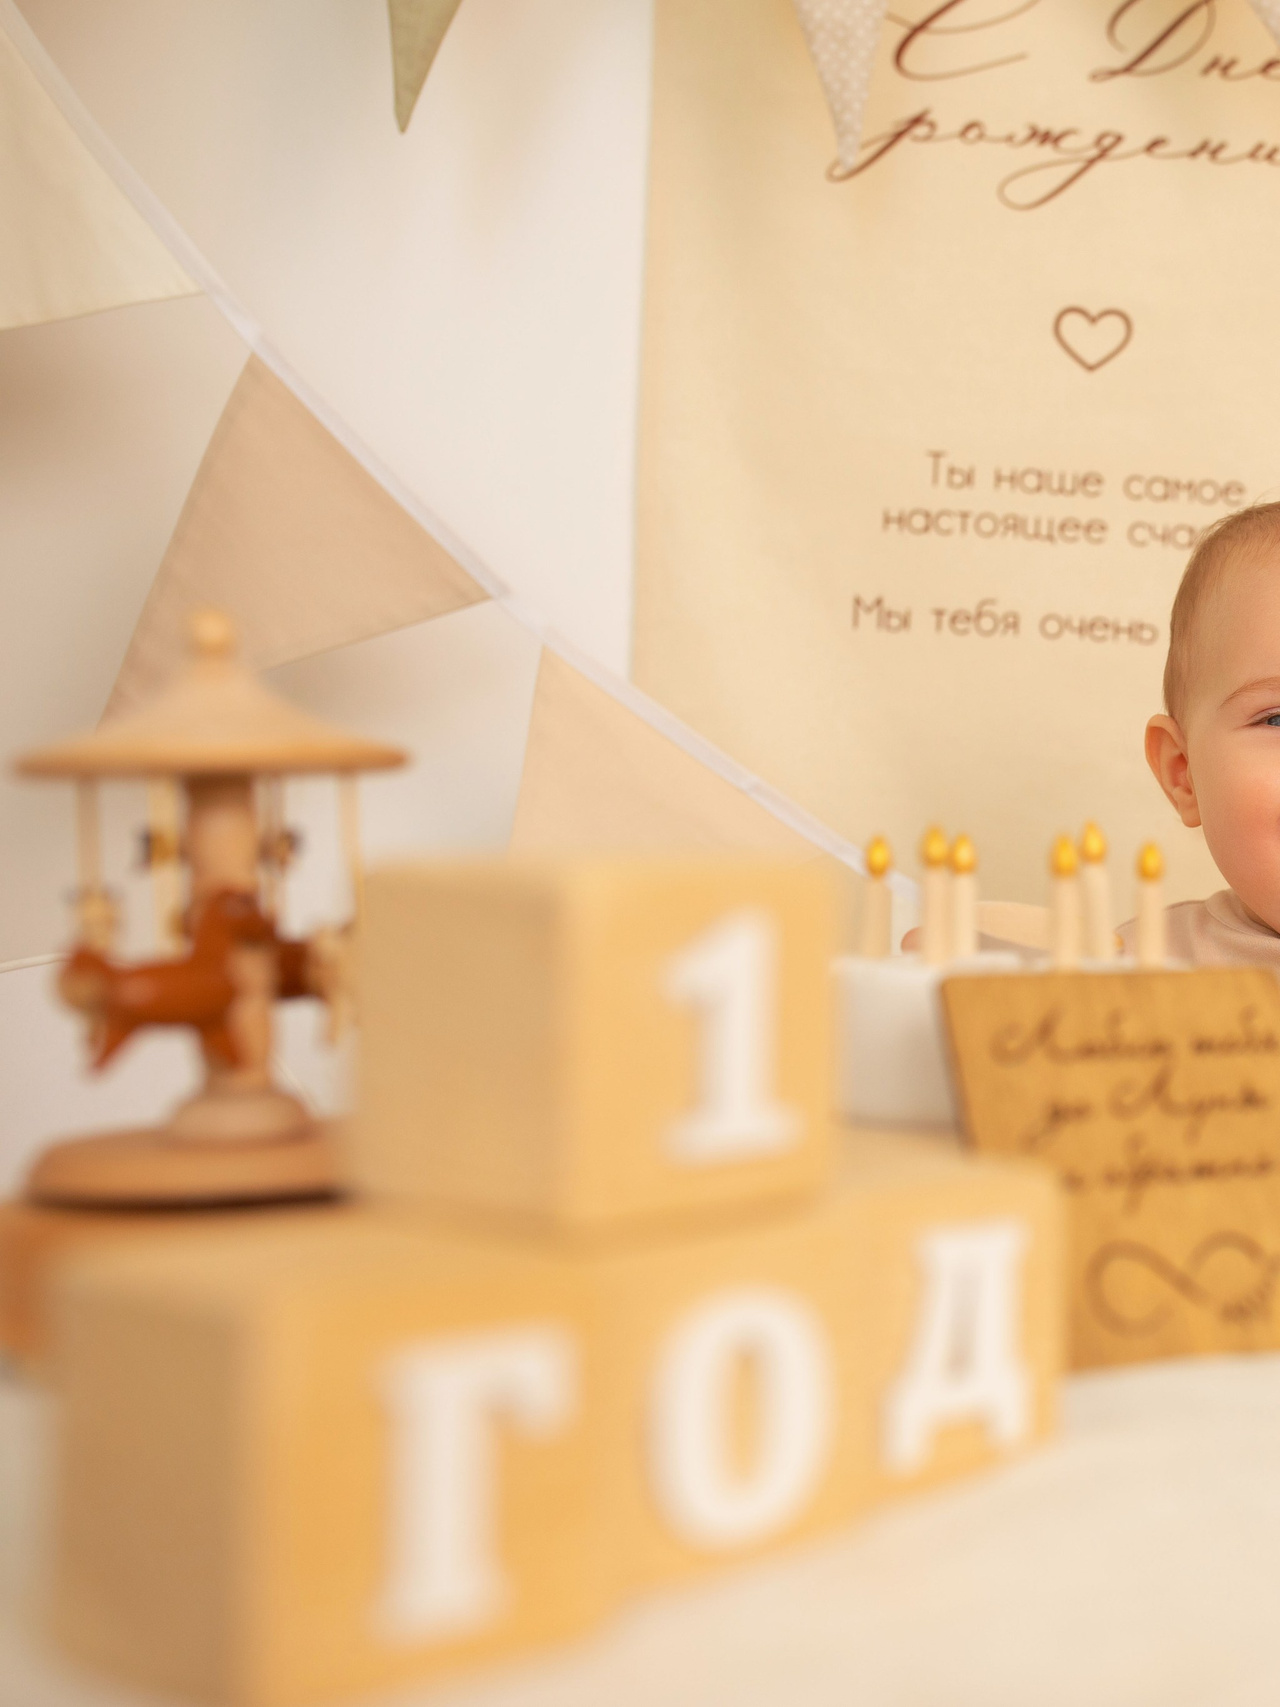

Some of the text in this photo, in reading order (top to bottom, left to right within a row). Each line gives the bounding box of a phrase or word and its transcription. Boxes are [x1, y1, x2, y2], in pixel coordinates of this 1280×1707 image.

[926, 450, 1248, 506] Ты наше самое
[881, 507, 1109, 545] настоящее
[851, 594, 1160, 646] Мы тебя очень
[659, 905, 803, 1165] 1
